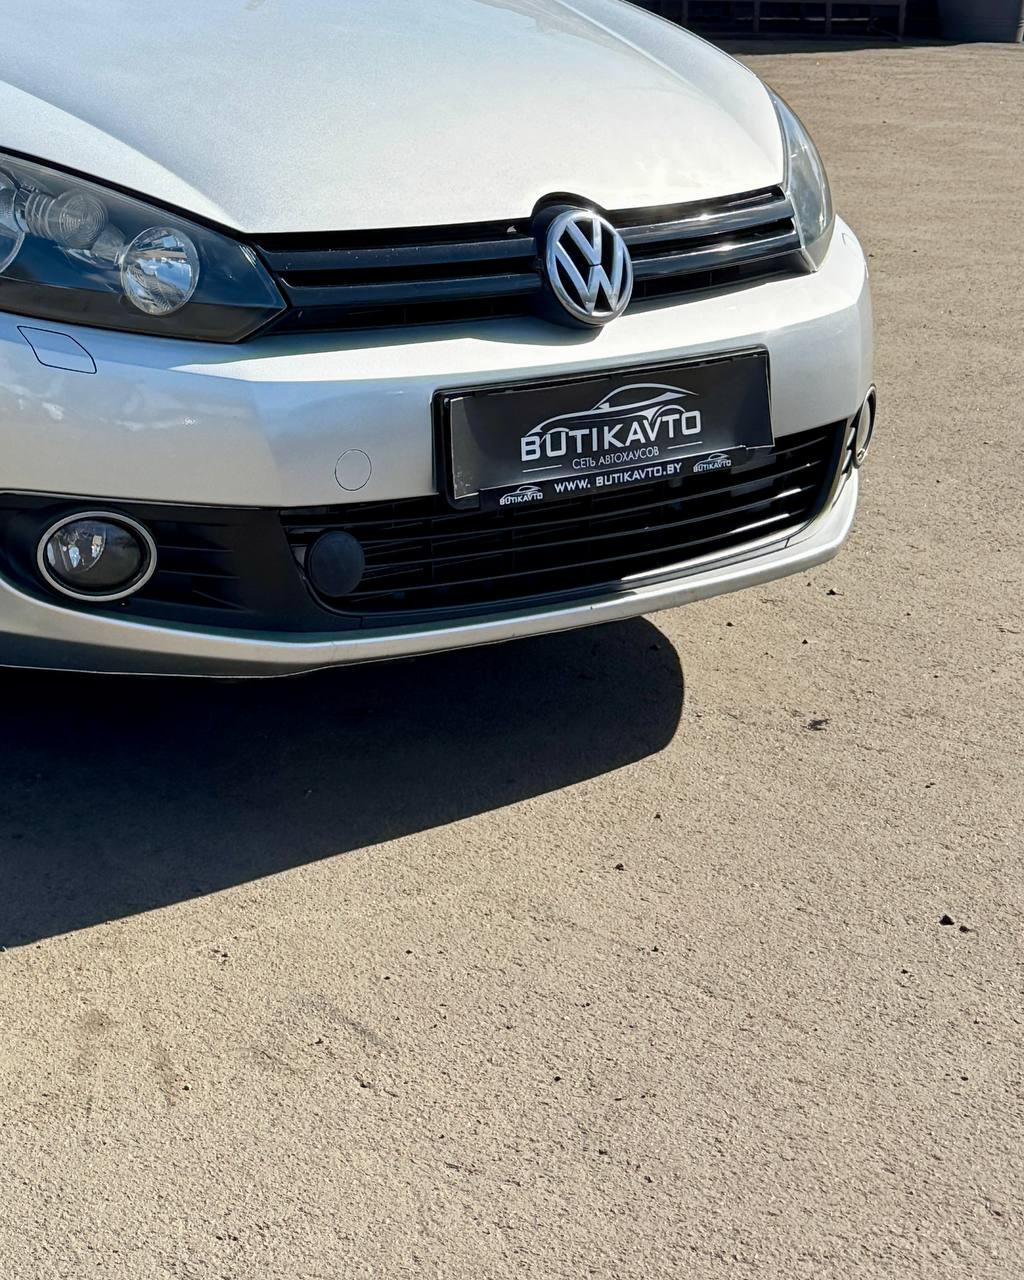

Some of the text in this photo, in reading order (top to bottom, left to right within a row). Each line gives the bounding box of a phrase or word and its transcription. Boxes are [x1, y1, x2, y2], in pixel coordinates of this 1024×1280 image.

[521, 410, 702, 462] BUTIKAVTO
[572, 446, 660, 469] СЕТЬ АВТОХАУСОВ
[693, 459, 732, 473] BUTIKAVTO
[499, 491, 544, 506] BUTIKAVTO
